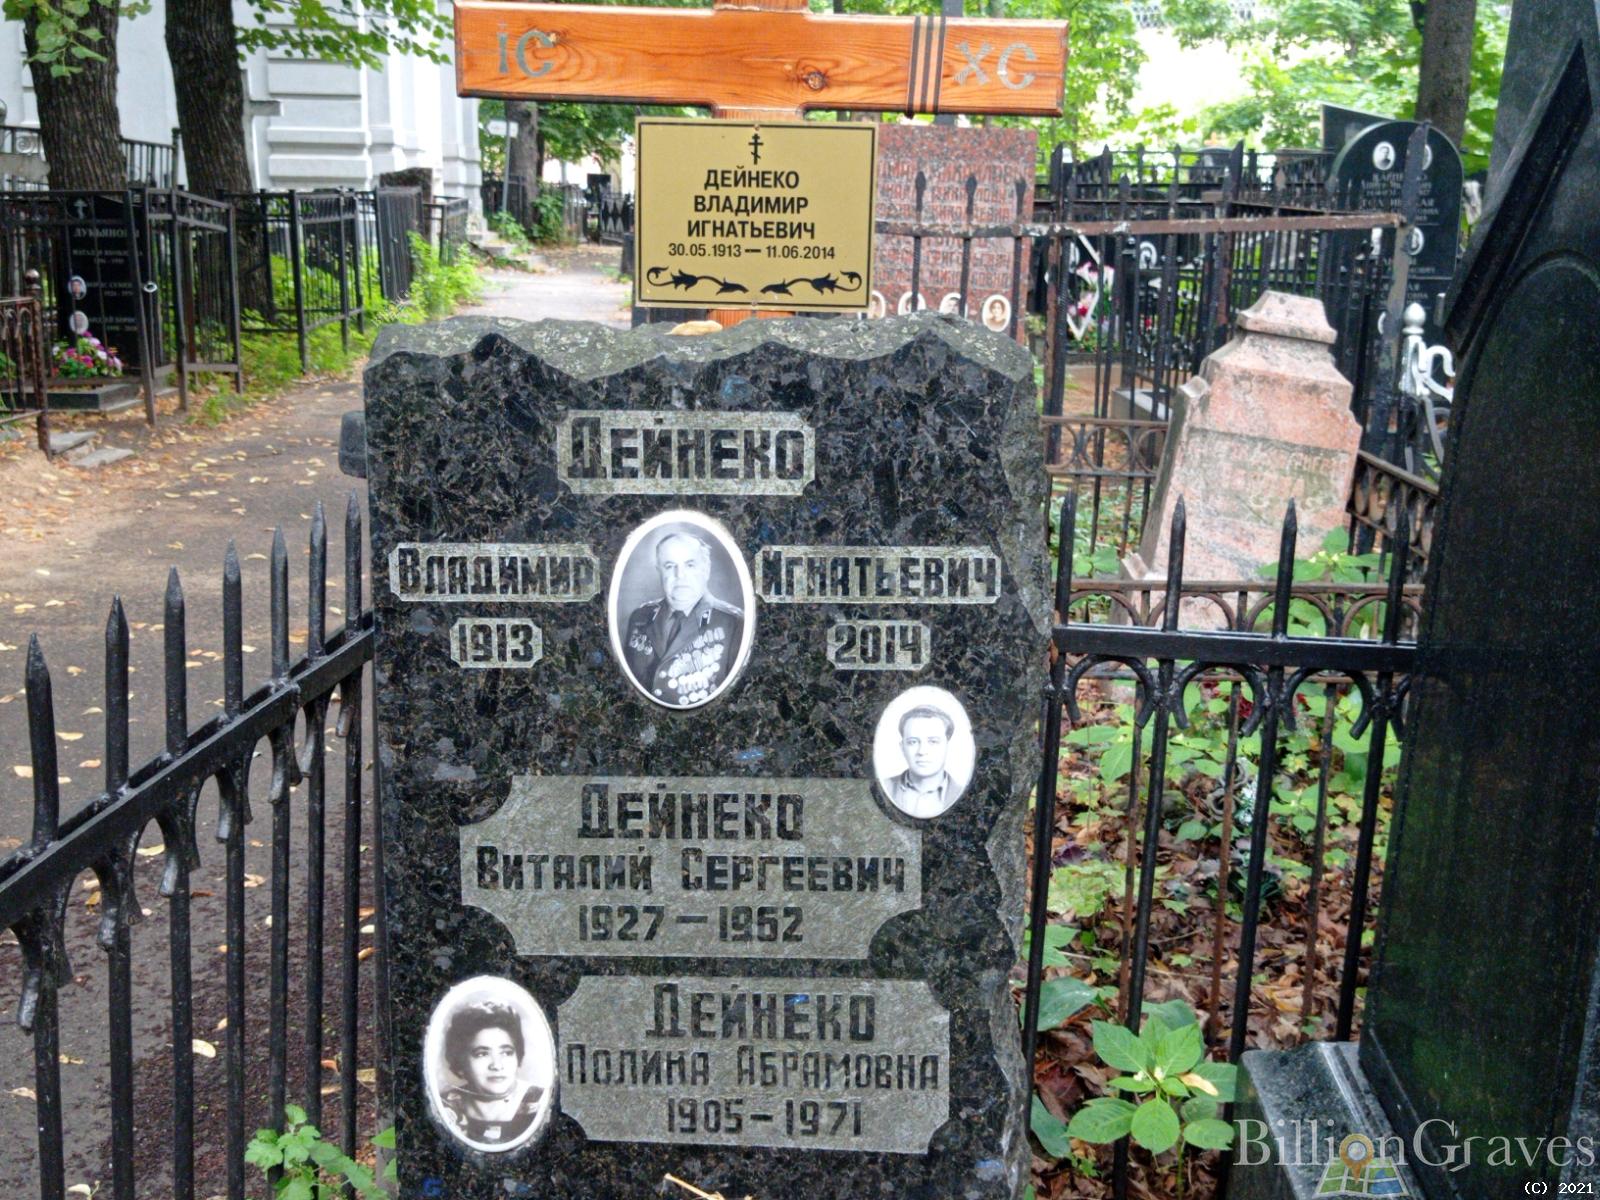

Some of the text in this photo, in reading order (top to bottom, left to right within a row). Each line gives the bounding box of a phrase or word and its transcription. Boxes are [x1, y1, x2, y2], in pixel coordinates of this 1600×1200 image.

[704, 166, 799, 190] ДЕЙНЕКО
[694, 195, 809, 216] ВЛАДИМИР
[687, 220, 815, 239] ИГНАТЬЕВИЧ
[668, 243, 742, 257] 30.05.1913
[766, 245, 835, 259] 11.06.2014
[567, 416, 805, 480] ДЕЙНЕКО
[398, 547, 997, 597] ВЛАДИМИР ИГНАТЬЕВИЧ
[458, 623, 922, 664] 1913 2014
[578, 783, 804, 841] ДЕЙНЕКО
[476, 845, 905, 893] ВИТАЛИЙ СЕРГЕЕВИЧ
[578, 905, 665, 942] 1927
[646, 983, 876, 1042] ДЕЙНЕКО
[566, 1043, 939, 1090] ПОЛИНА АБРАМОВНА
[667, 1098, 743, 1133] 1905
[786, 1099, 862, 1136] 1971
